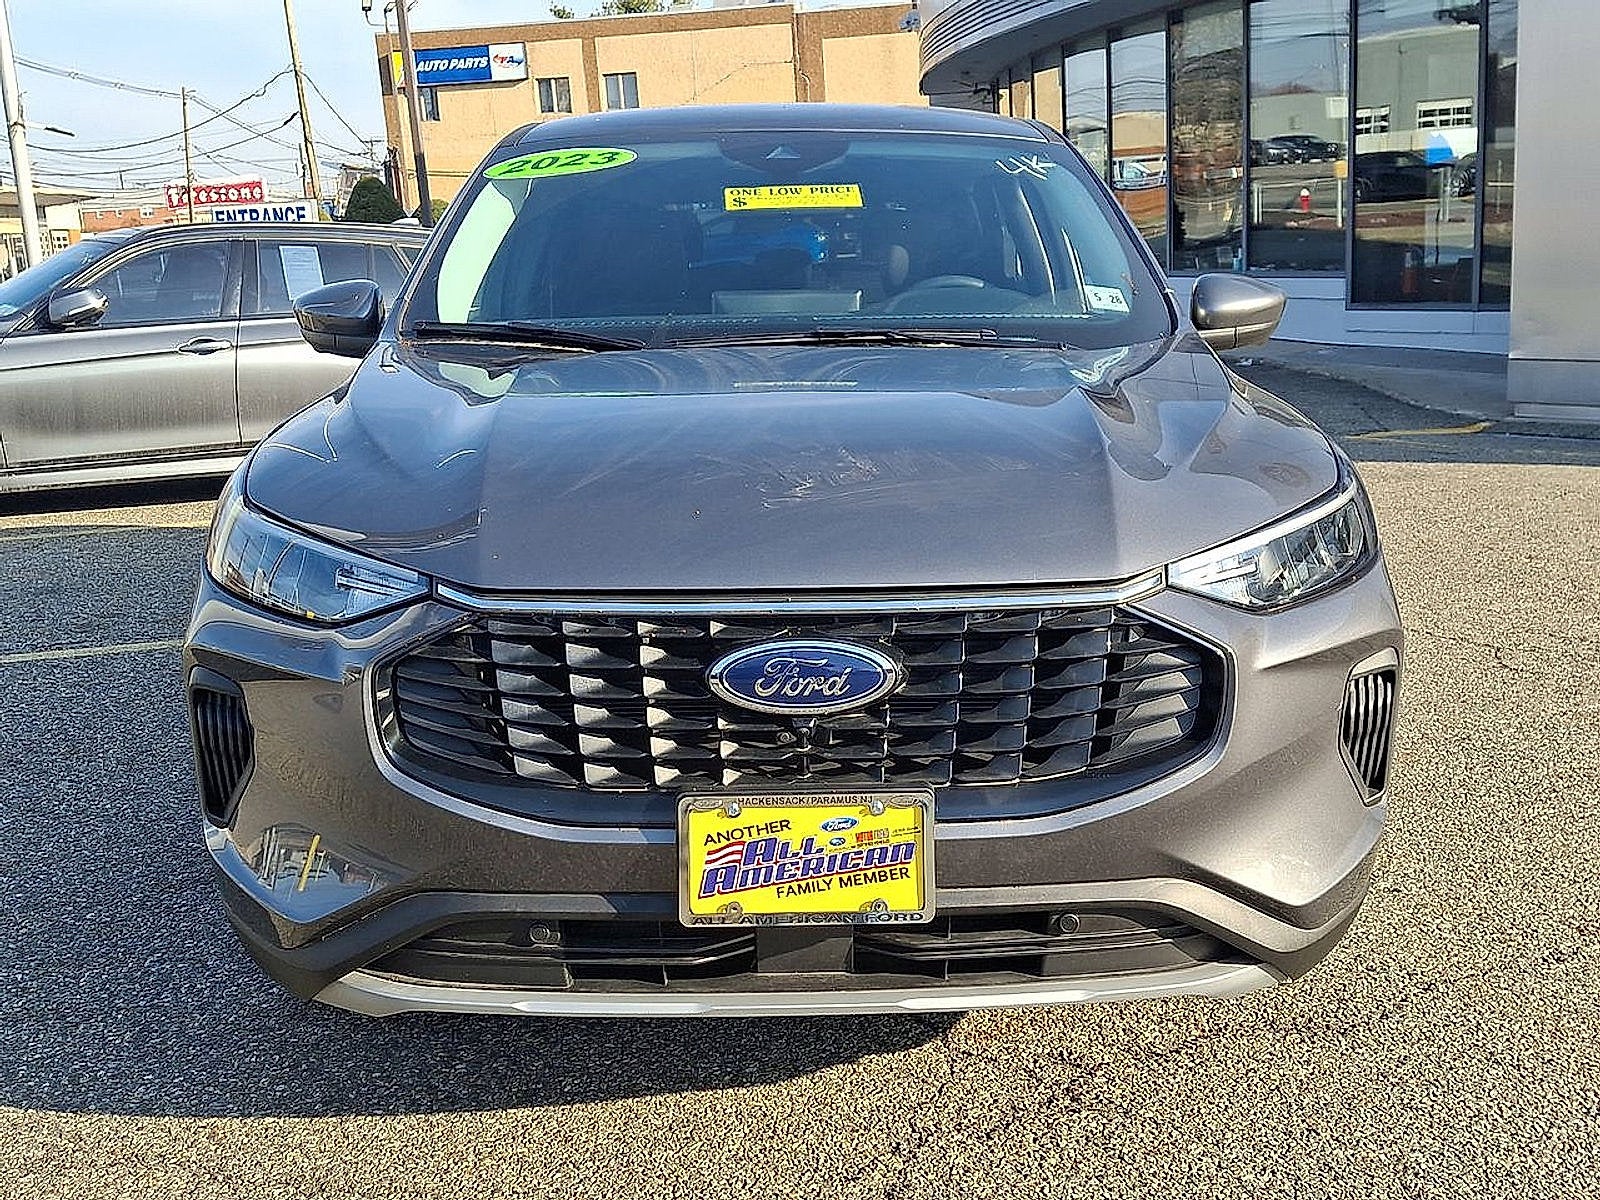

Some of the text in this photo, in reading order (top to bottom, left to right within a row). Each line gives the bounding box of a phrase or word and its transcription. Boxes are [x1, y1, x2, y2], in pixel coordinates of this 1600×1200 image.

[416, 59, 448, 73] AUTO
[450, 57, 488, 70] PARTS
[498, 152, 620, 176] 2023
[730, 186, 854, 196] ONE LOW PRICE
[214, 206, 306, 222] ENTRANCE
[754, 657, 852, 697] Ford
[704, 819, 792, 846] ANOTHER
[743, 834, 824, 866] ALL
[700, 842, 917, 898] AMERICAN
[776, 867, 911, 898] FAMILY MEMBER
[858, 912, 925, 924] FORD
